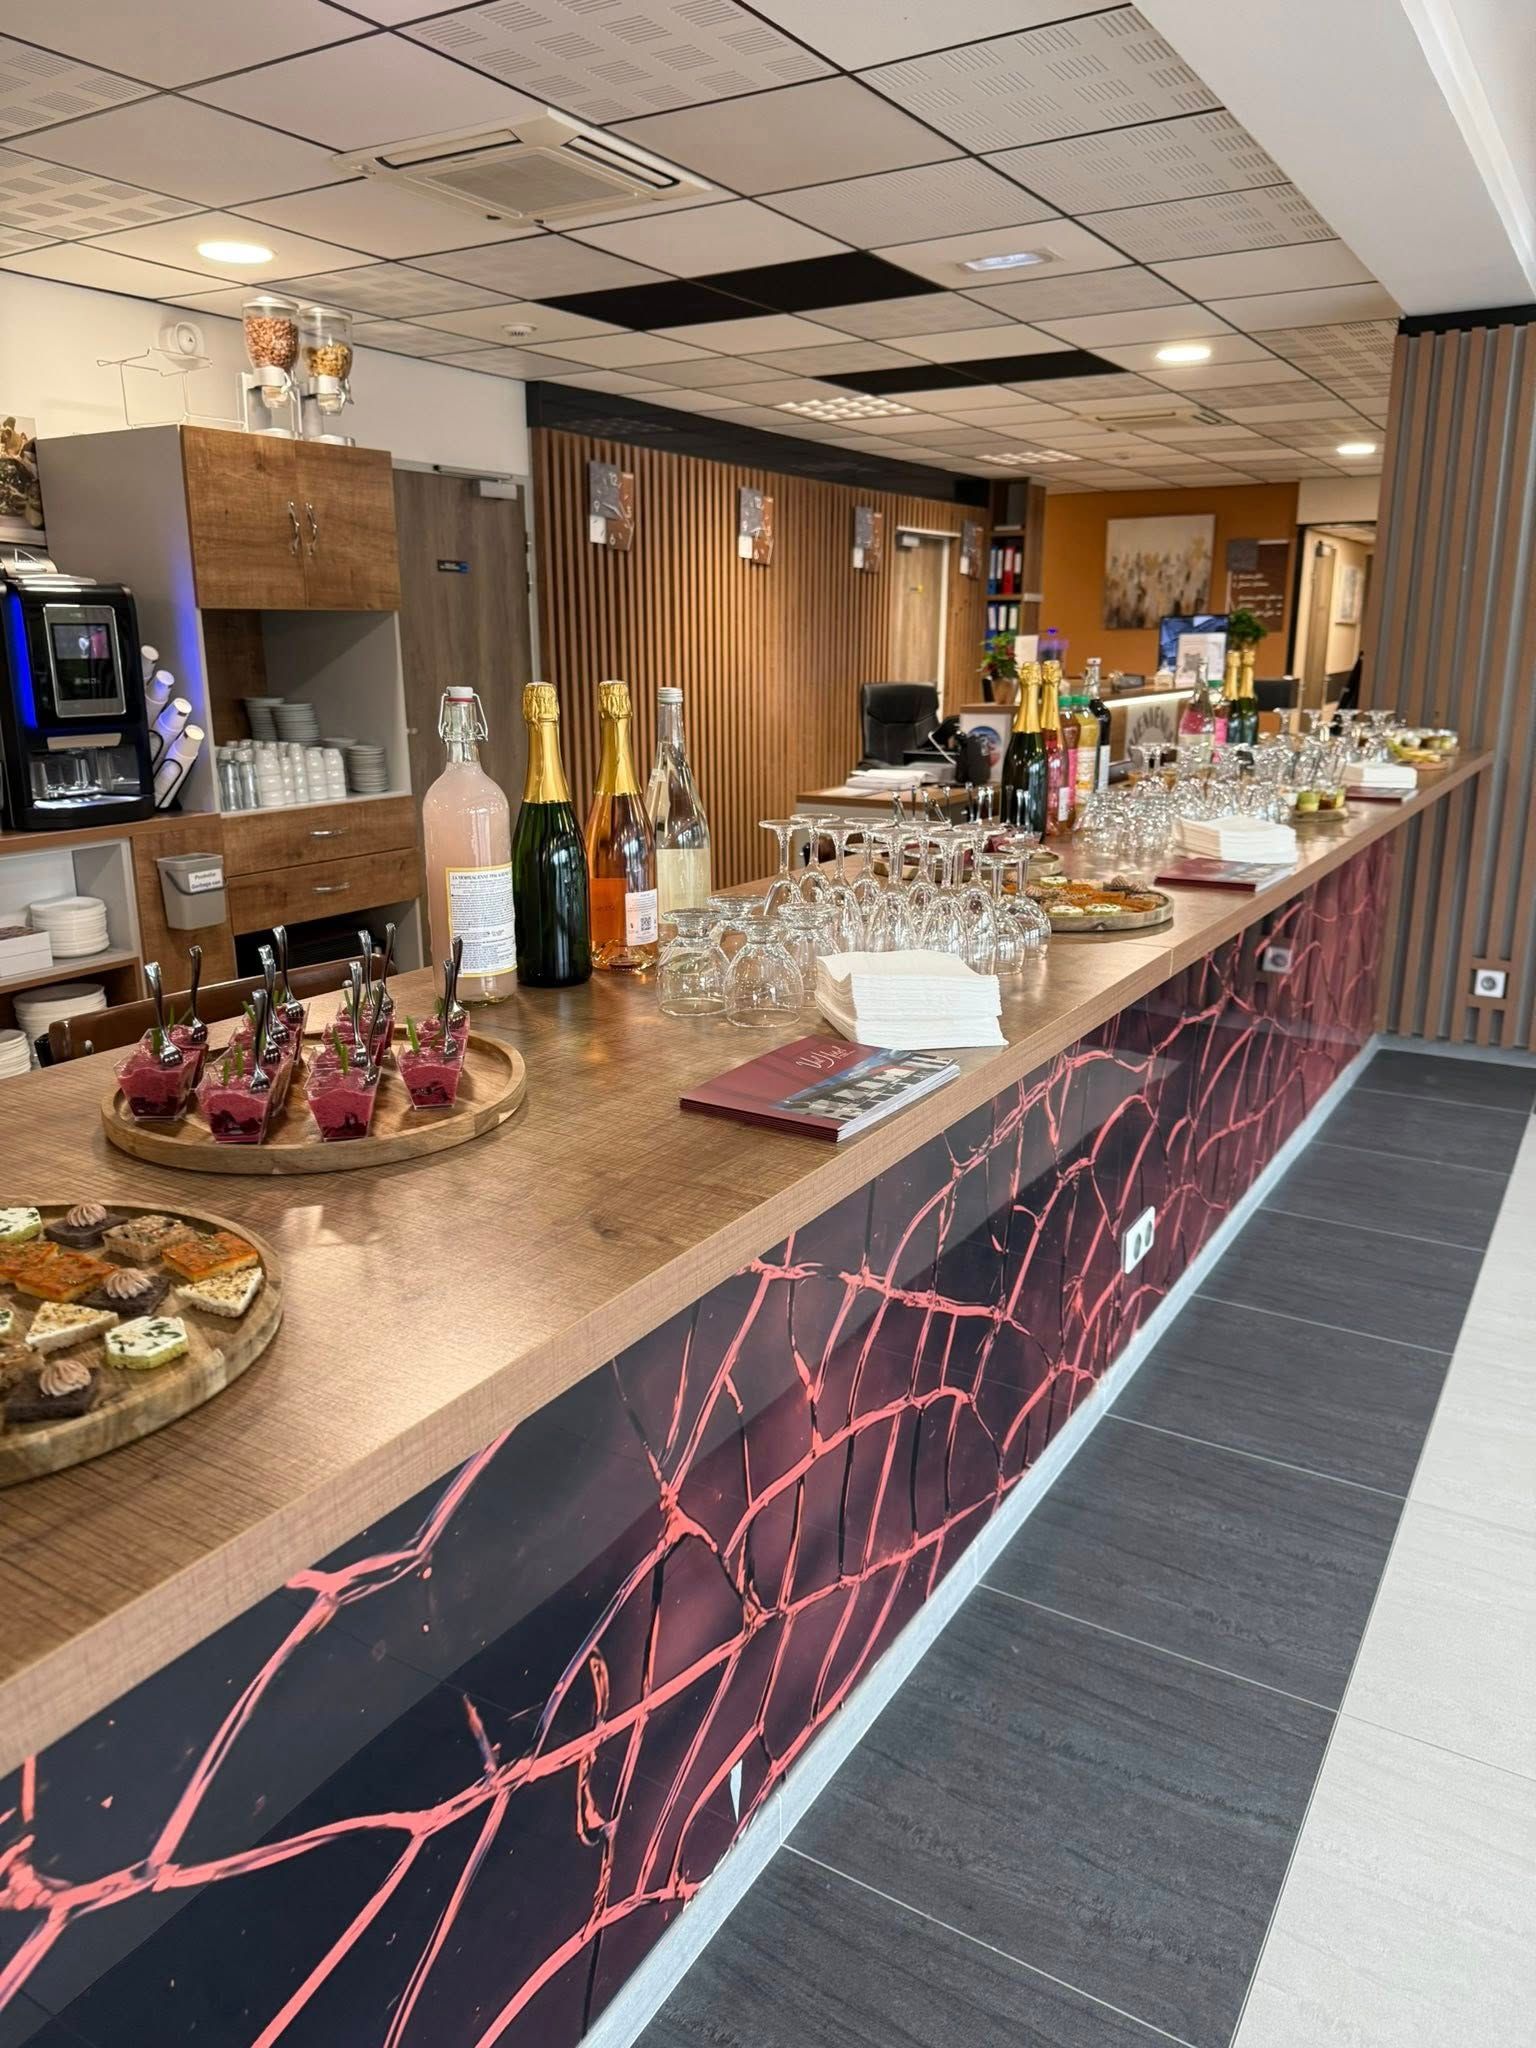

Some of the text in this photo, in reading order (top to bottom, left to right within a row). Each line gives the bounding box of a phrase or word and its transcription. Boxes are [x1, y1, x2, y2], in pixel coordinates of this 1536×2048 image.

[608, 472, 618, 486] 12
[593, 500, 601, 513] 9
[609, 533, 616, 545] 6
